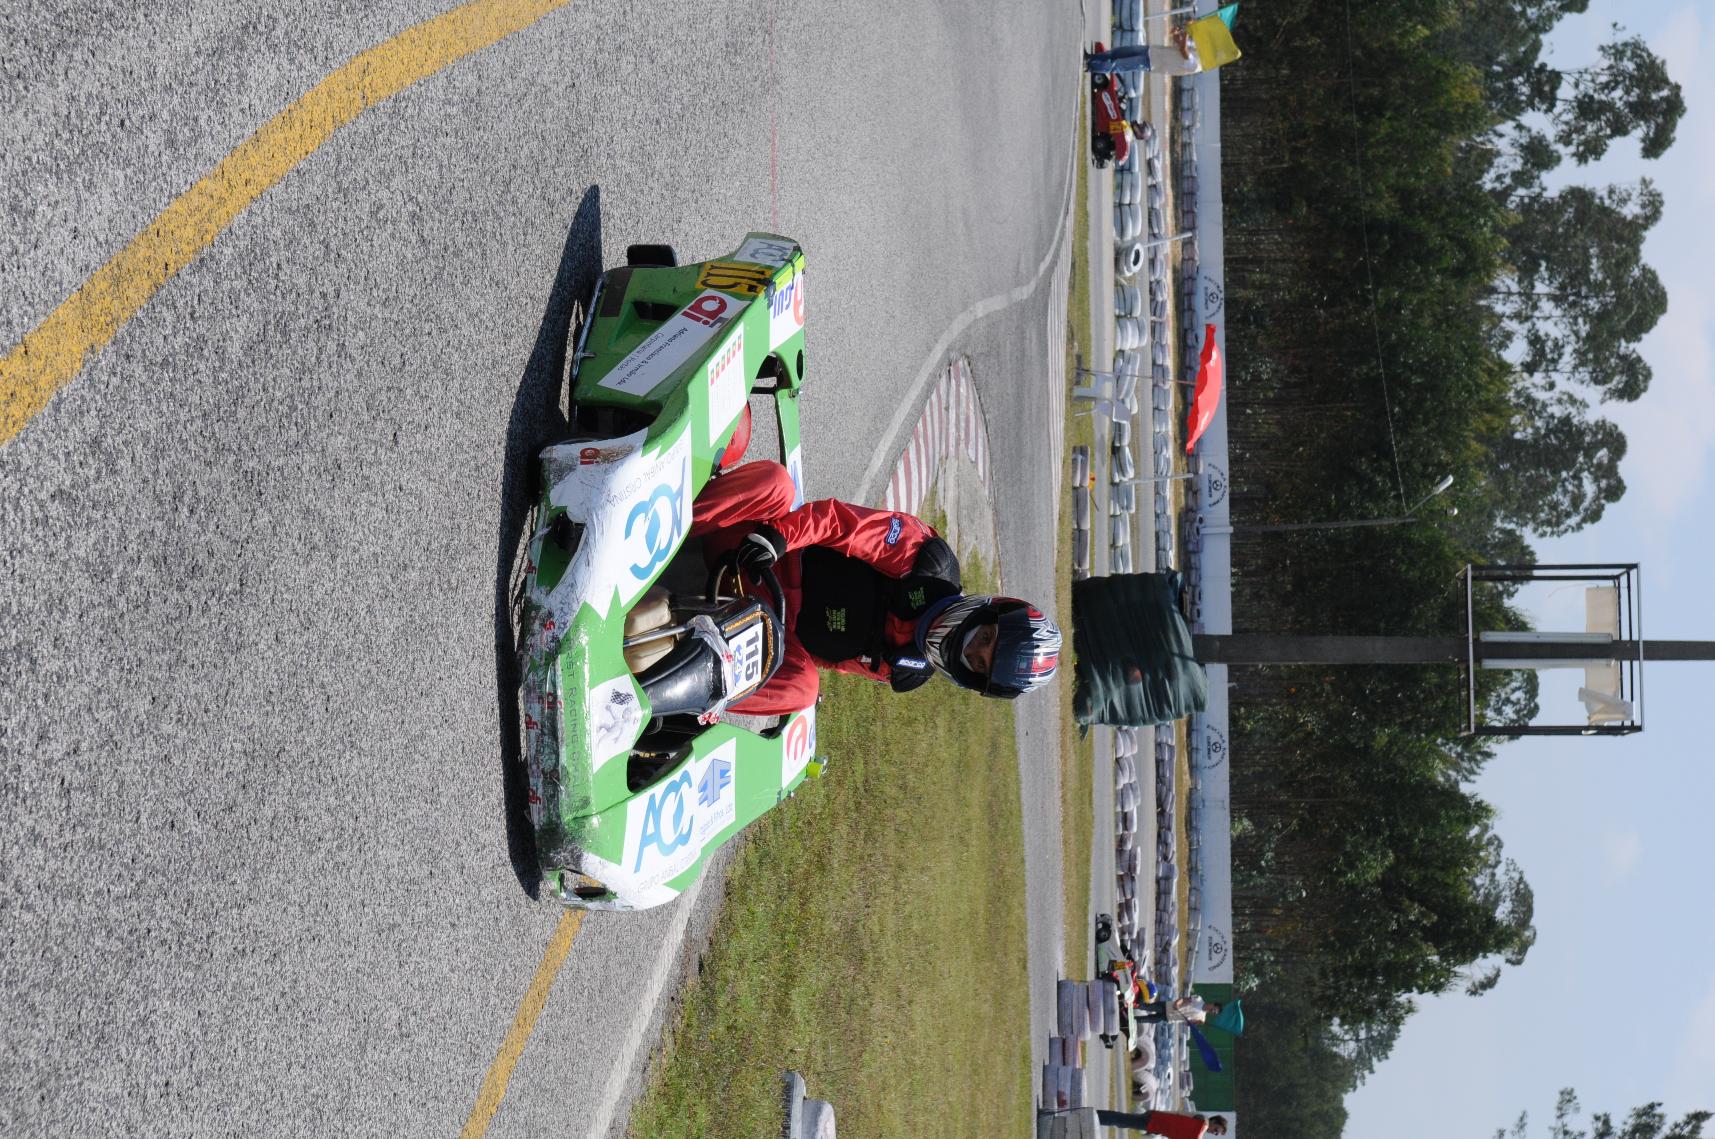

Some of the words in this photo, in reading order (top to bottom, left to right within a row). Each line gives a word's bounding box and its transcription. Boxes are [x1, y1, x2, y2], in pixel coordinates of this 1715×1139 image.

[700, 264, 769, 293] 115
[666, 327, 688, 343] Adriano
[646, 342, 670, 360] Francisco
[745, 631, 760, 682] 115
[568, 688, 578, 743] RACING
